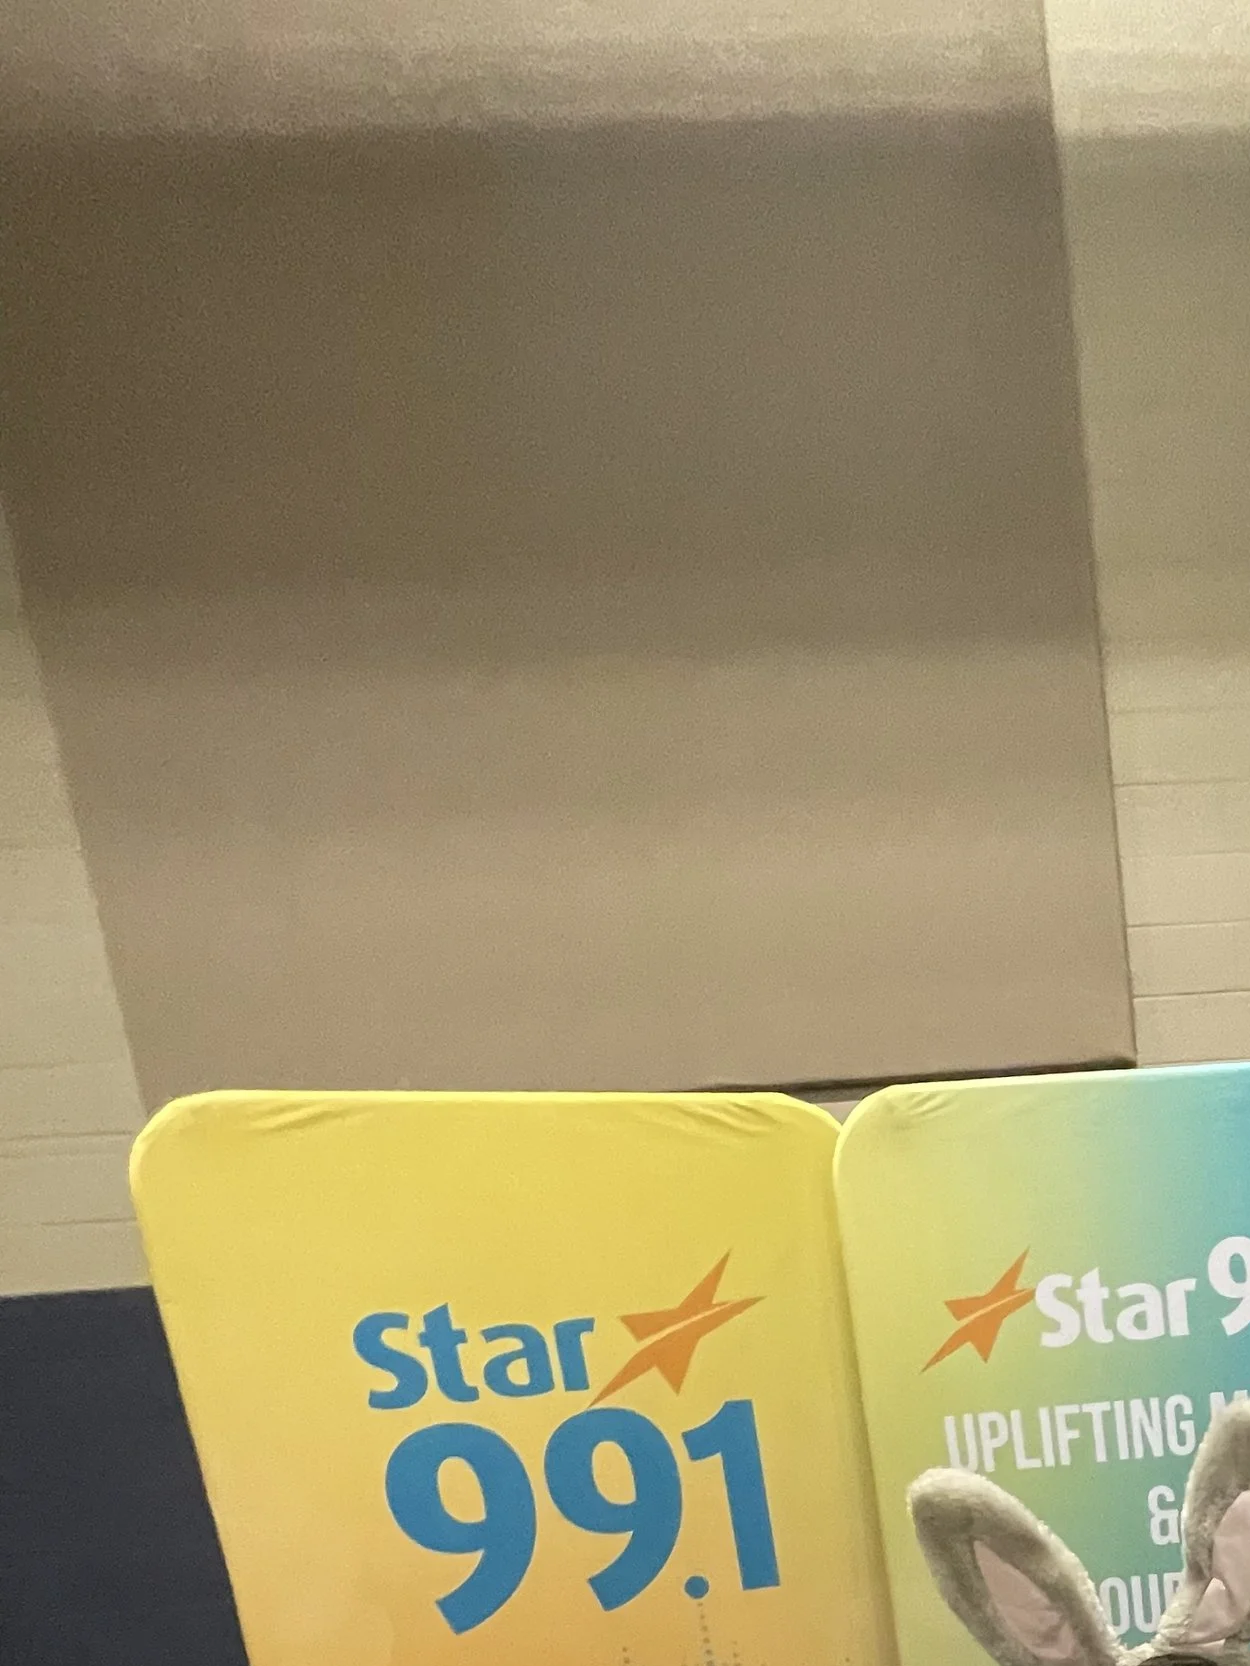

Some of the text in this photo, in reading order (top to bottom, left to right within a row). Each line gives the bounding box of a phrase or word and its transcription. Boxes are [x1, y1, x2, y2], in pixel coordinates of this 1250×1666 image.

[1035, 1267, 1197, 1348] Star
[352, 1302, 595, 1410] Star
[943, 1393, 1196, 1473] UPLIFTING
[385, 1398, 781, 1636] 99.1
[1147, 1484, 1180, 1546] &
